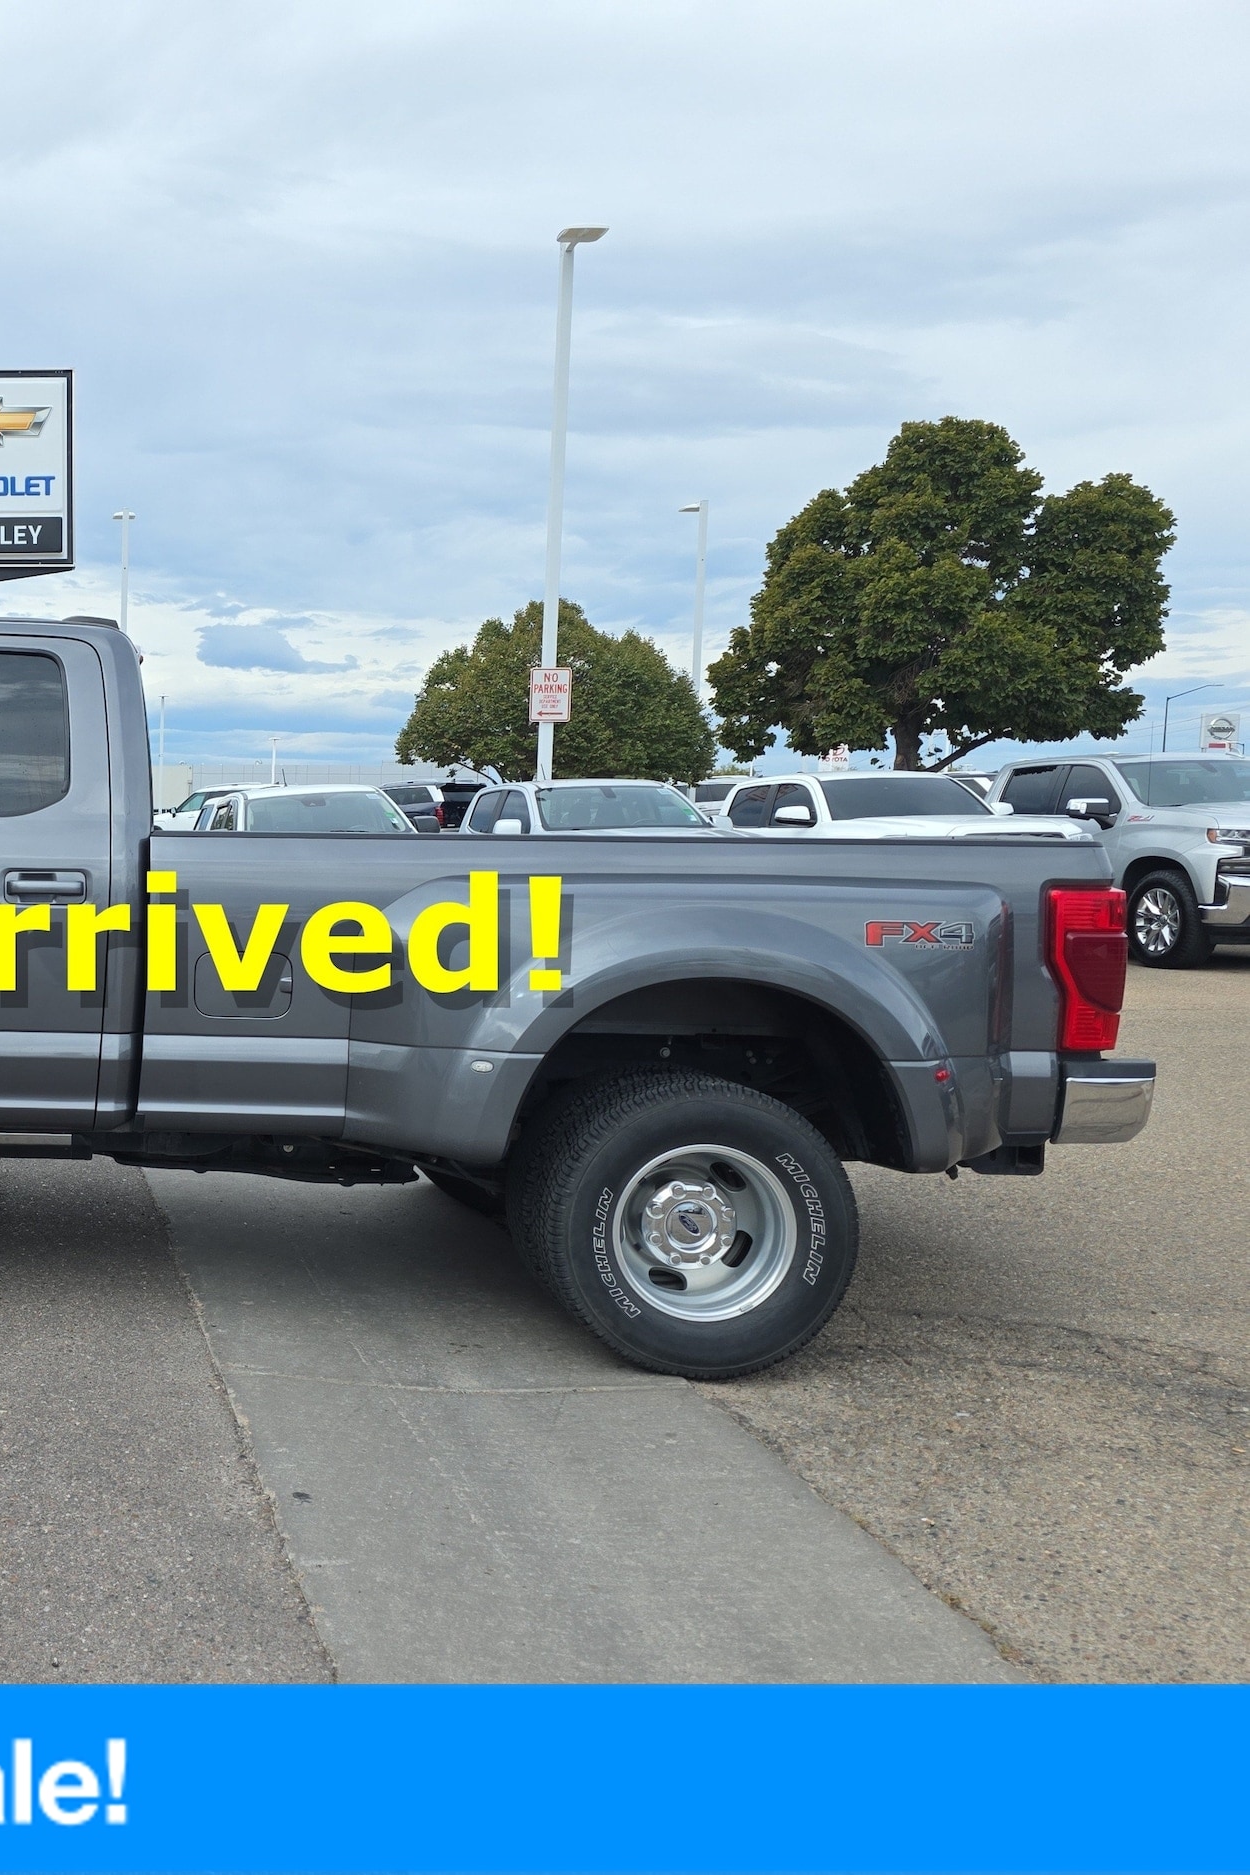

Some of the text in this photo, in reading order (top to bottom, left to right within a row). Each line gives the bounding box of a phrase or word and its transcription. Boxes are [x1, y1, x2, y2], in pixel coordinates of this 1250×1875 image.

[533, 683, 568, 694] PARKING
[543, 672, 559, 683] NO
[864, 919, 975, 948] FX4
[775, 1152, 826, 1286] MICHELIN
[592, 1186, 642, 1319] MICHELIN
